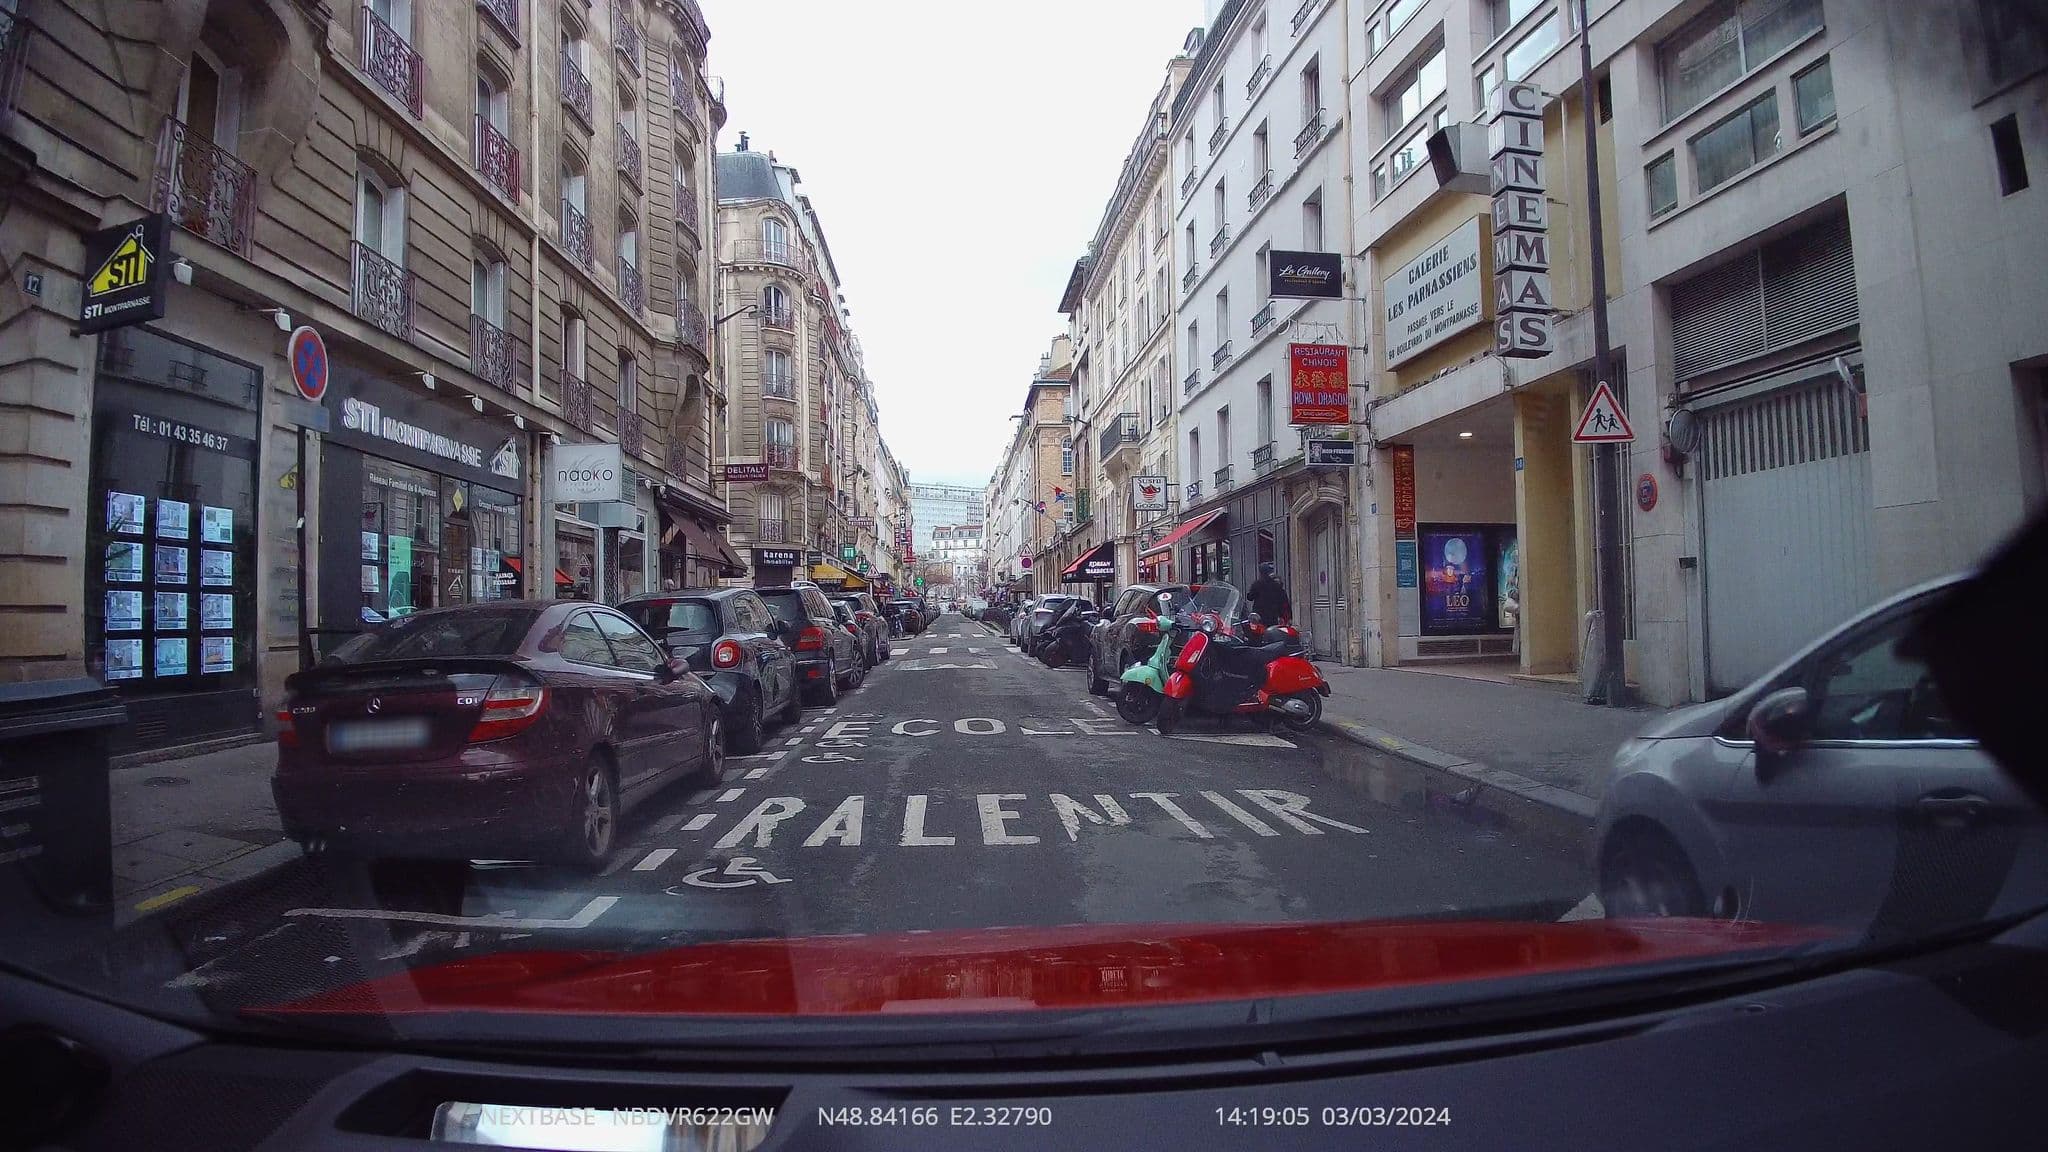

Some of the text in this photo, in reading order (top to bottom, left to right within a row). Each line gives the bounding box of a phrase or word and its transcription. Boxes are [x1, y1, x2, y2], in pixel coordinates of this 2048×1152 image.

[1508, 85, 1547, 347] CINEMAS
[108, 252, 140, 288] STI
[1408, 245, 1450, 284] GALERIE
[27, 275, 39, 292] 17
[1388, 253, 1477, 322] LES PARNASSIENS
[84, 296, 151, 319] STI MONTPARNASSE
[1407, 300, 1455, 335] PASSAGE VERS LE
[1397, 334, 1423, 356] BOULEVARD
[1425, 328, 1432, 340] DU
[1434, 302, 1478, 335] MONTPARNASSE
[1294, 347, 1345, 356] RESTAURANT
[1302, 358, 1338, 367] CHINOIS
[1294, 391, 1348, 406] ROYAL DRAGON
[133, 414, 150, 432] Tél
[159, 420, 171, 437] 01
[174, 425, 186, 441] 43
[189, 429, 201, 445] 35
[203, 432, 215, 448] 46
[216, 436, 228, 451] 37
[342, 397, 482, 468] STI MONTPARNASSE
[727, 466, 766, 474] DELITALY
[899, 507, 907, 541] HOTEL
[763, 550, 794, 559] karena
[457, 697, 478, 705] CDI
[821, 717, 1139, 739] ECOLE
[713, 788, 1371, 850] RALENTIR
